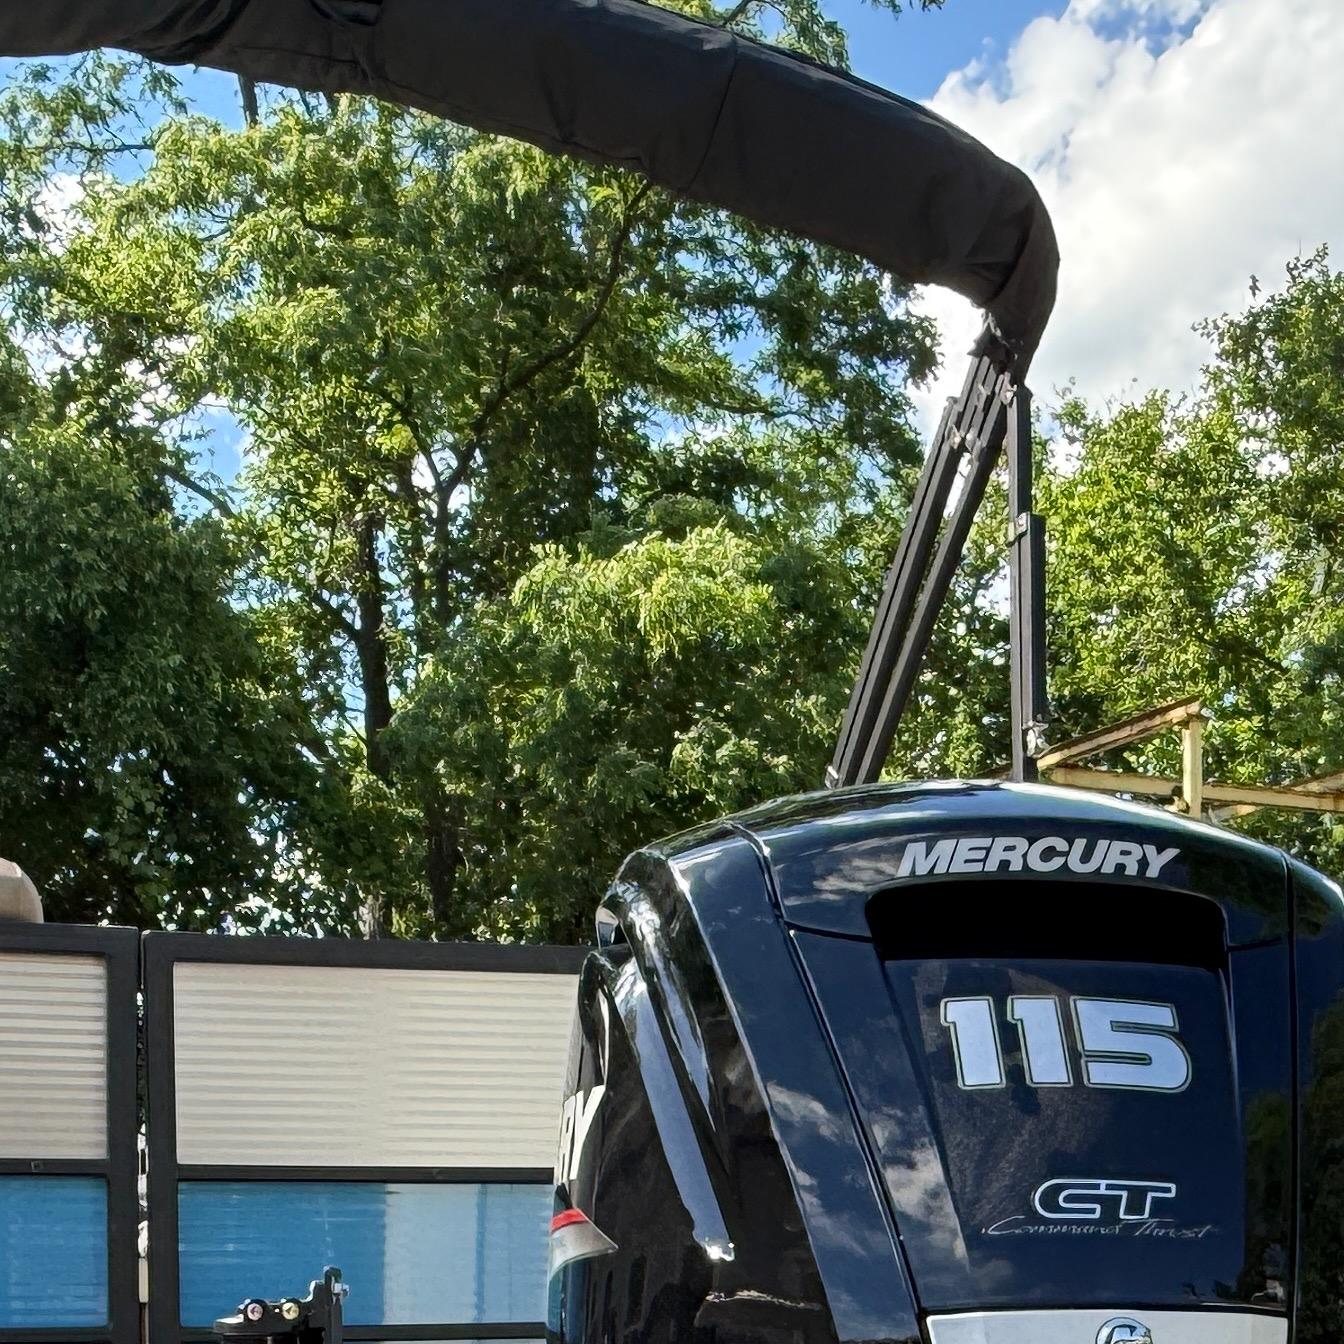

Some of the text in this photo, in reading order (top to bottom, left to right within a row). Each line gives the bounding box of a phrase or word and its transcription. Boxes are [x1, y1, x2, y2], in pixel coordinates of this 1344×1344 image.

[896, 836, 1181, 878] MERCURY
[940, 995, 1192, 1093] 115
[1033, 1178, 1177, 1218] GT
